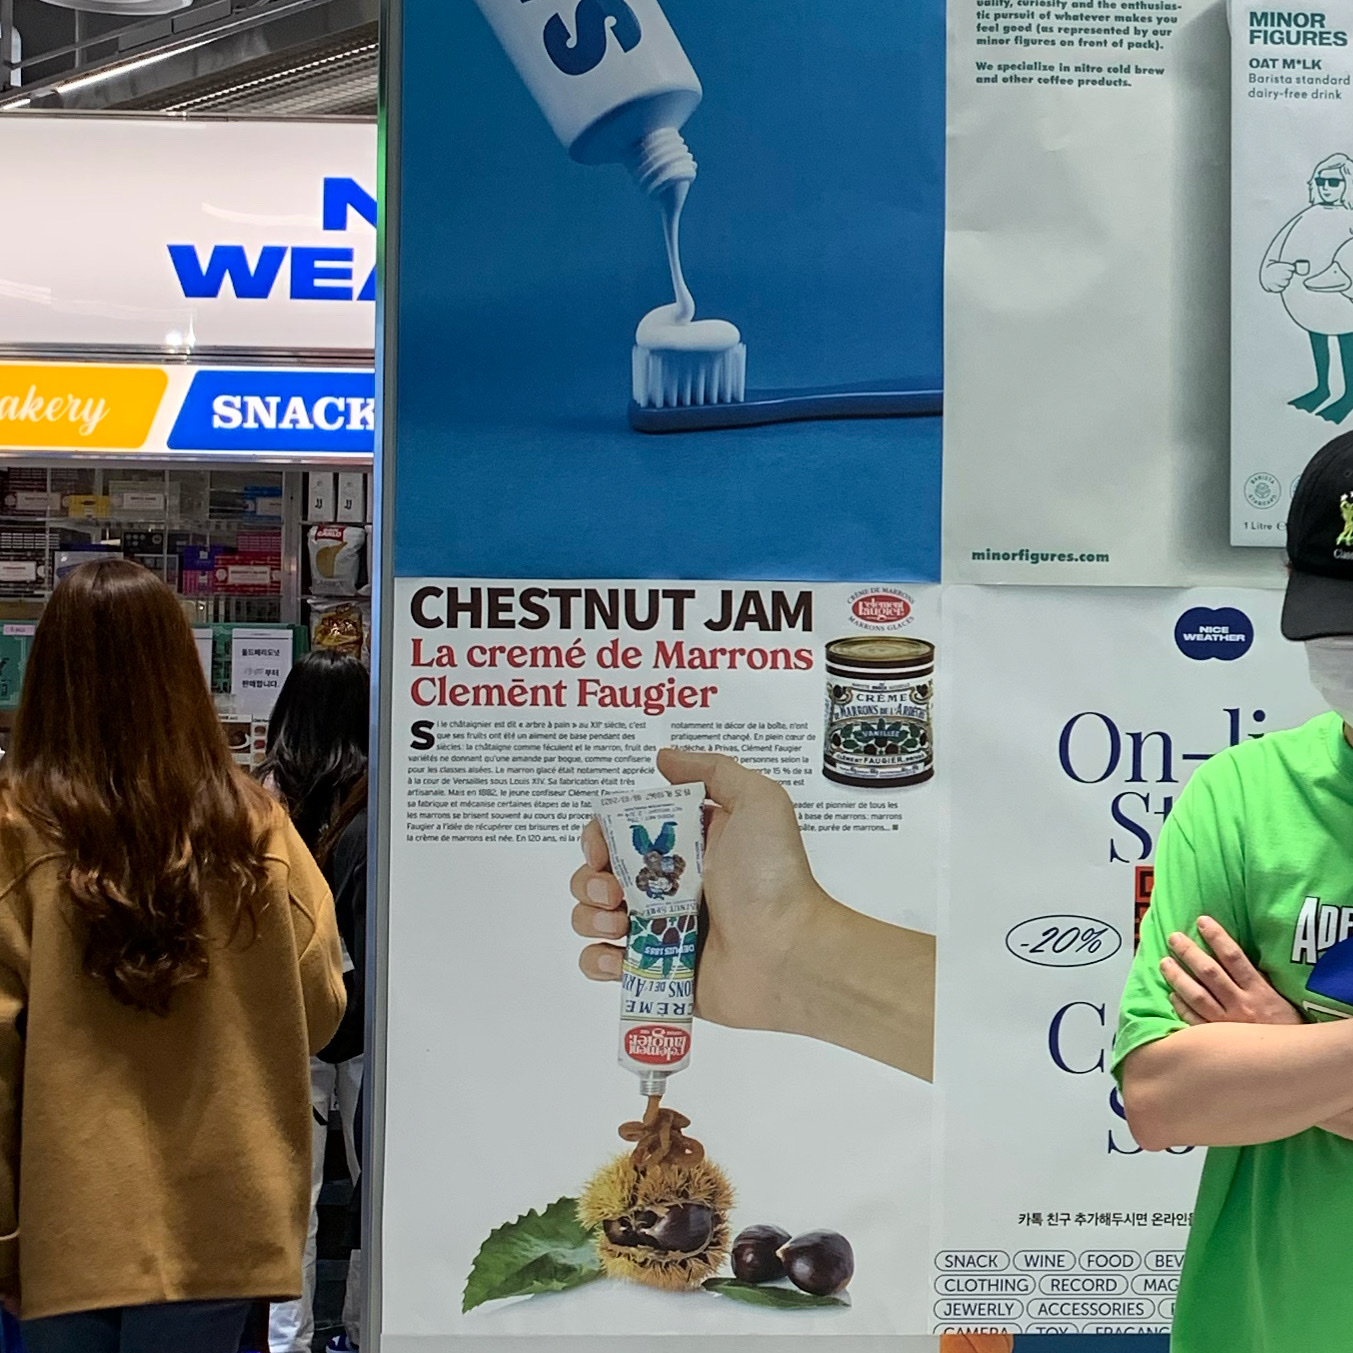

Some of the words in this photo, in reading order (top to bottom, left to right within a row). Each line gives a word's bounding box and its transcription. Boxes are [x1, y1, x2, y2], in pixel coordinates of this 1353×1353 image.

[1121, 1, 1182, 11] enthusias-
[977, 11, 990, 20] tic
[994, 11, 1035, 21] pursuit
[1039, 11, 1052, 20] of
[1055, 12, 1110, 22] whatever
[1114, 14, 1152, 23] makes
[1156, 15, 1177, 25] you
[1249, 11, 1326, 29] MINOR
[977, 23, 999, 32] feel
[1003, 24, 1032, 35] good
[1037, 24, 1053, 34] (as
[1058, 26, 1130, 36] represented
[1134, 27, 1148, 38] by
[1248, 30, 1348, 46] FIGURES
[977, 37, 1010, 45] minor
[1014, 37, 1056, 47] figures
[1060, 38, 1074, 47] on
[1079, 38, 1107, 47] front
[1112, 39, 1124, 48] of
[1127, 40, 1164, 50] pack).
[976, 62, 993, 71] We
[998, 62, 1055, 73] specialize
[1059, 63, 1070, 72] in
[1074, 63, 1103, 74] nitro
[1107, 64, 1130, 74] cold
[1135, 65, 1164, 75] brew
[1248, 58, 1284, 70] OAT
[976, 75, 998, 84] and
[1002, 75, 1033, 84] other
[1037, 75, 1074, 85] coffee
[1078, 77, 1132, 87] products.
[1248, 74, 1292, 86] Barista
[1296, 74, 1350, 86] standard
[1248, 87, 1307, 100] dairy-free
[1311, 88, 1343, 100] drink
[211, 395, 375, 430] SNACK
[971, 548, 1110, 564] minorfigures.com
[410, 586, 695, 631] CHESTNUT
[704, 589, 813, 632] JAM
[1199, 625, 1230, 635] NICE
[1183, 633, 1246, 643] WEATHER
[410, 638, 457, 668] La
[466, 638, 586, 669] cremé
[597, 638, 641, 669] de
[652, 641, 814, 671] Marrons
[410, 676, 567, 708] Clemēnt
[577, 678, 718, 716] Faugier
[856, 693, 908, 702] CRÈME
[1019, 924, 1109, 955] -20%
[1018, 1212, 1043, 1228] 카톡
[1047, 1212, 1071, 1228] 친구
[1074, 1212, 1148, 1228] 추가해두시면
[944, 1254, 998, 1269] SNACK
[1024, 1254, 1066, 1268] WINE
[1087, 1254, 1134, 1268] FOOD
[943, 1278, 1029, 1293] CLOTHING
[1050, 1278, 1118, 1293] RECORD
[943, 1302, 1015, 1317] JEWERLY
[1037, 1302, 1145, 1316] ACCESSORIES
